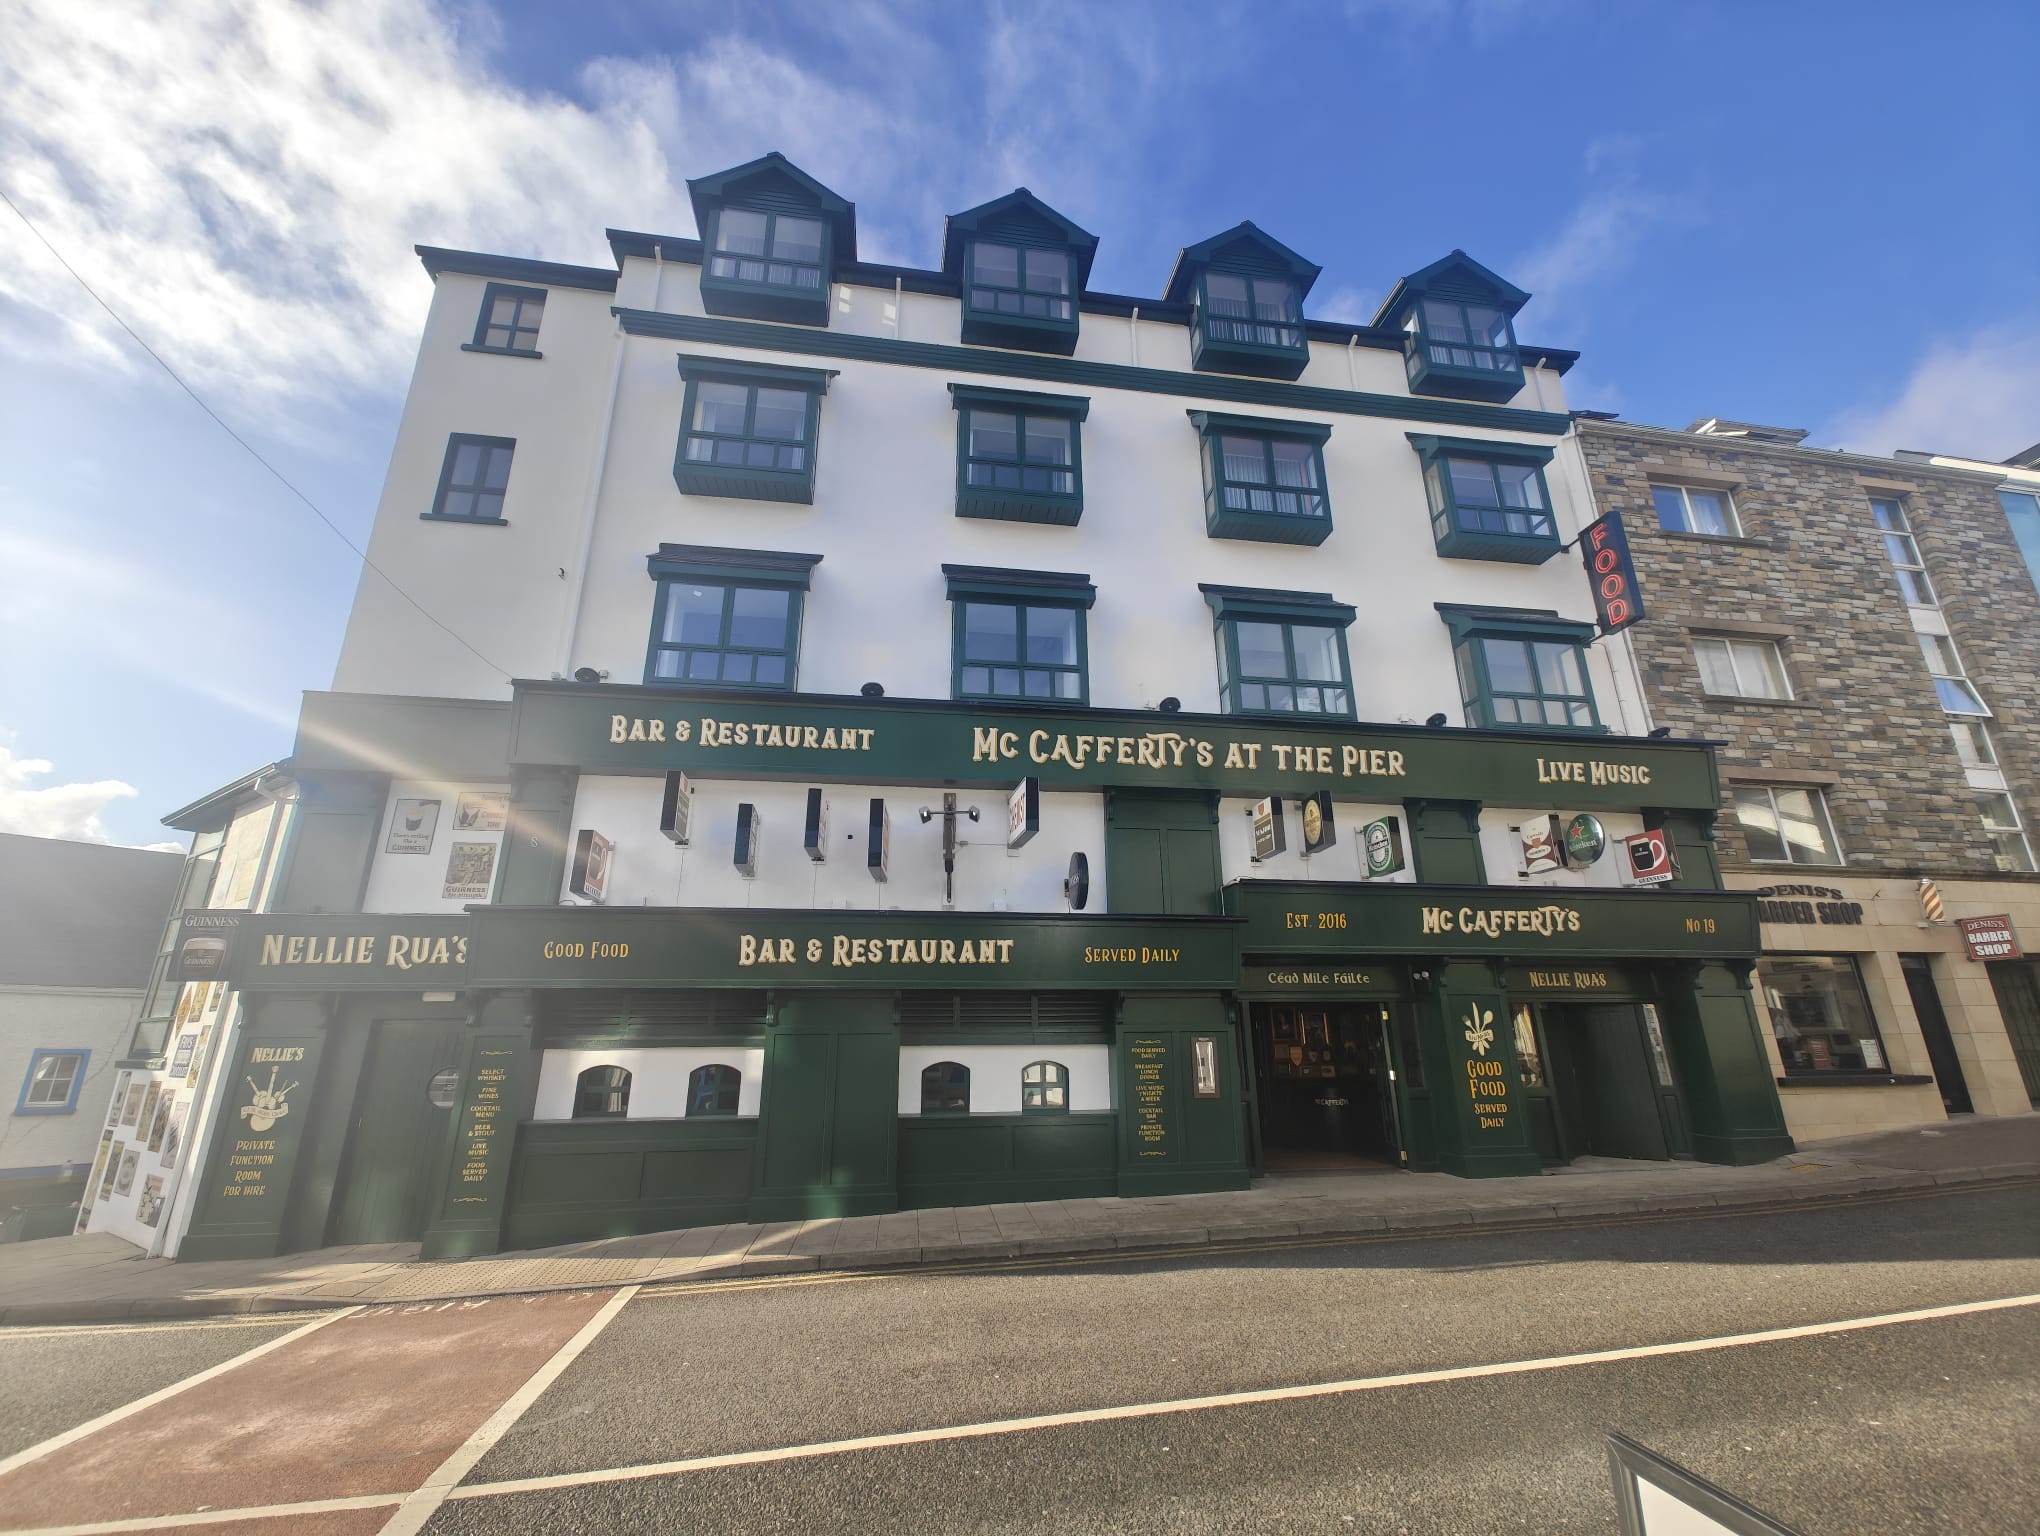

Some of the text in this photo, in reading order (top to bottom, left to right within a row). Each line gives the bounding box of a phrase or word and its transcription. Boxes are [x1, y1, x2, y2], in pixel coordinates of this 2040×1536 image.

[1590, 522, 1629, 625] FOOD
[609, 714, 875, 751] BAR & RESTAURANT
[1029, 729, 1214, 770] CAFFERTY'S
[1224, 743, 1262, 770] AT
[1272, 744, 1333, 773] THE
[1341, 745, 1407, 778] PIER
[1536, 759, 1651, 786] LIVE MUSIC
[1638, 874, 1669, 884] GUINNESS
[445, 885, 486, 893] GUINNESS
[185, 914, 241, 928] GUINNESS
[1318, 912, 1347, 929] 2016
[1758, 901, 1864, 925] ARBER SHOP
[1458, 905, 1582, 938] CAFFERTY'S
[1702, 918, 1716, 934] 19
[1967, 920, 2005, 931] DENIS'S
[1968, 930, 2012, 944] BARBER
[259, 933, 468, 970] NELLIE RUA'S
[543, 940, 630, 960] GOOD FOOD
[738, 935, 1014, 968] BAR & RESTAURANT
[1084, 946, 1181, 964] SERVED DAILY
[1974, 943, 2012, 957] SHOP
[1528, 971, 1571, 988] NELLIE
[250, 1047, 305, 1063] NELLIE'S
[1466, 1059, 1503, 1078] GOOD
[1469, 1079, 1506, 1099] FOOD
[1474, 1102, 1507, 1115] SERVED
[1480, 1116, 1505, 1129] DAILY
[235, 1140, 276, 1151] PRIVATE
[230, 1155, 274, 1166] FUNCTION
[235, 1170, 262, 1183] ROOM
[224, 1185, 266, 1196] FOR HIRE
